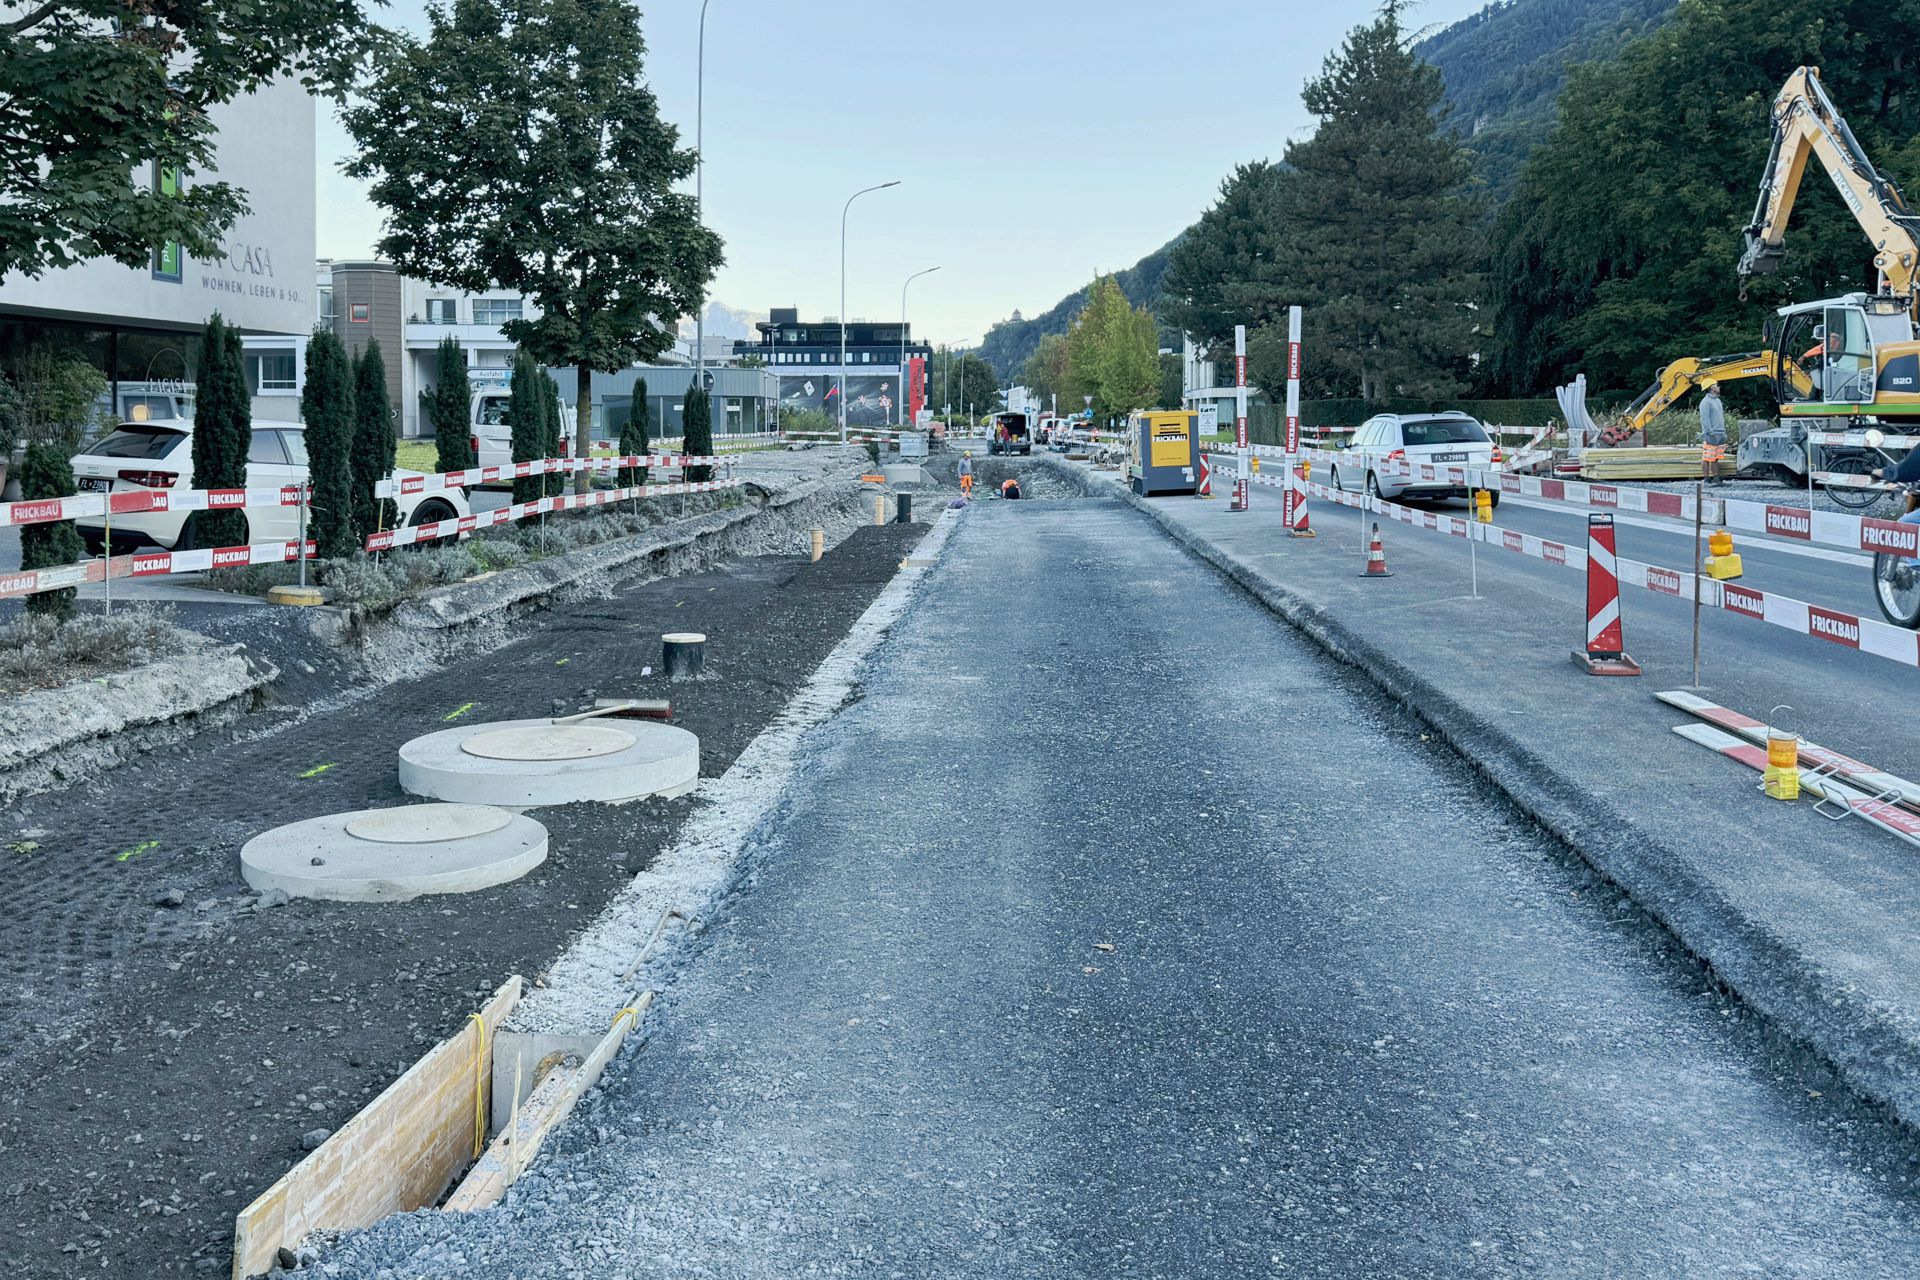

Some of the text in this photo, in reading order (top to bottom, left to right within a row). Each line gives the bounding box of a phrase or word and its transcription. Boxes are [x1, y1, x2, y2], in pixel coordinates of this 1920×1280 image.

[230, 243, 274, 277] CASA
[202, 276, 246, 296] WOHNEN,
[250, 284, 276, 298] LEBEN
[279, 288, 284, 300] &
[1290, 343, 1298, 379] FRICKBAU
[1288, 417, 1296, 452] FRICKBAU
[209, 493, 244, 505] FRICKBAU
[1285, 491, 1293, 525] FRICKBAU
[1590, 490, 1617, 503] FRICKBAU
[14, 503, 59, 520] FRICKBAU
[1767, 512, 1809, 534] FRICKBAU
[1863, 526, 1916, 550] FRICKBAU
[133, 558, 170, 572] RICKBAU
[214, 550, 249, 564] FRICKBAU
[0, 576, 34, 593] CKBAU
[1647, 571, 1679, 590] FRICKBAU
[1726, 590, 1764, 615] FRICKBAU
[1811, 614, 1858, 641] FRICKBAU
